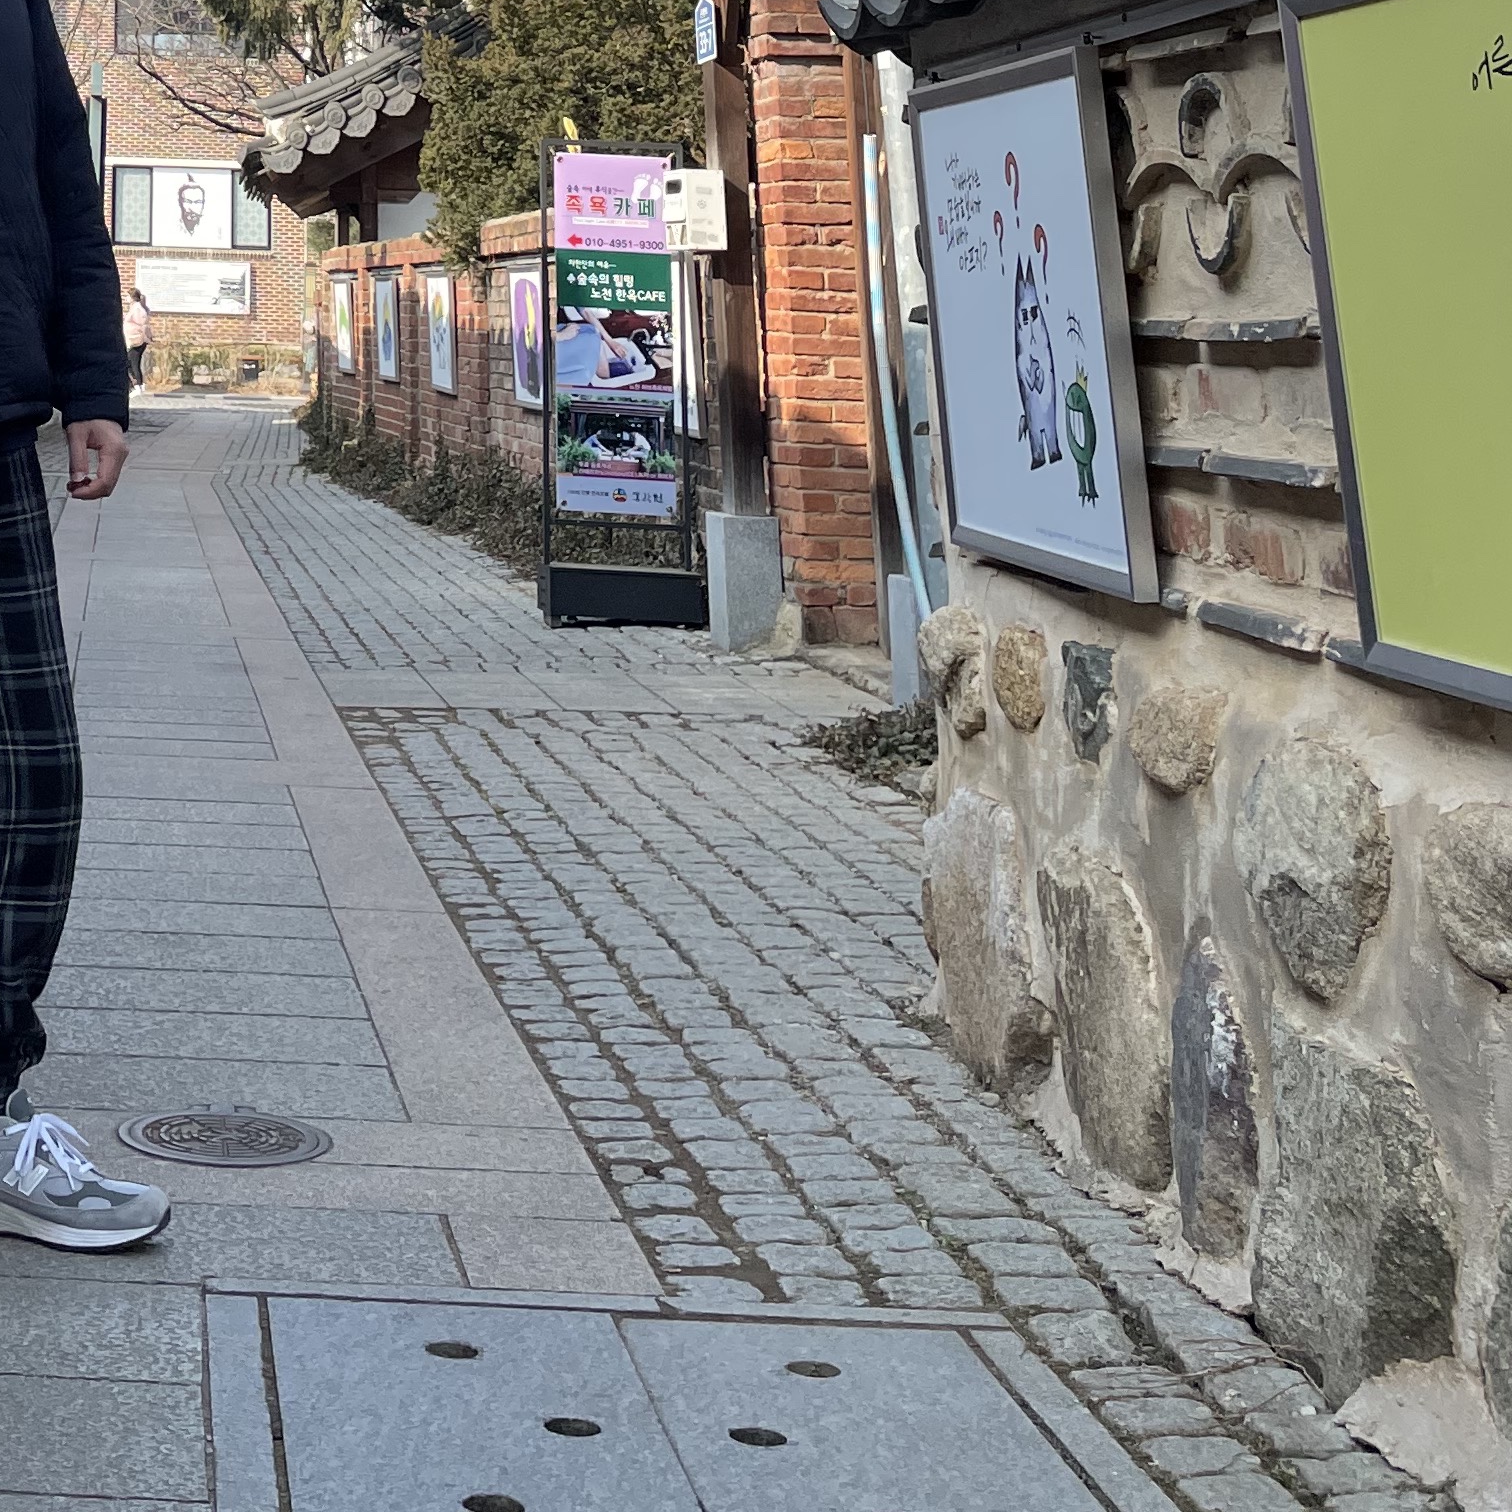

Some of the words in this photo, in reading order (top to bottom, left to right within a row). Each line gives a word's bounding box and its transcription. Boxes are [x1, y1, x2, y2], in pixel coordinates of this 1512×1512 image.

[565, 194, 656, 218] 족욕카페
[584, 237, 665, 251] 010-4951-9300
[958, 236, 988, 273] 아프지?
[576, 272, 610, 286] 숲속의
[612, 274, 635, 288] 힐링
[590, 287, 613, 302] 노천
